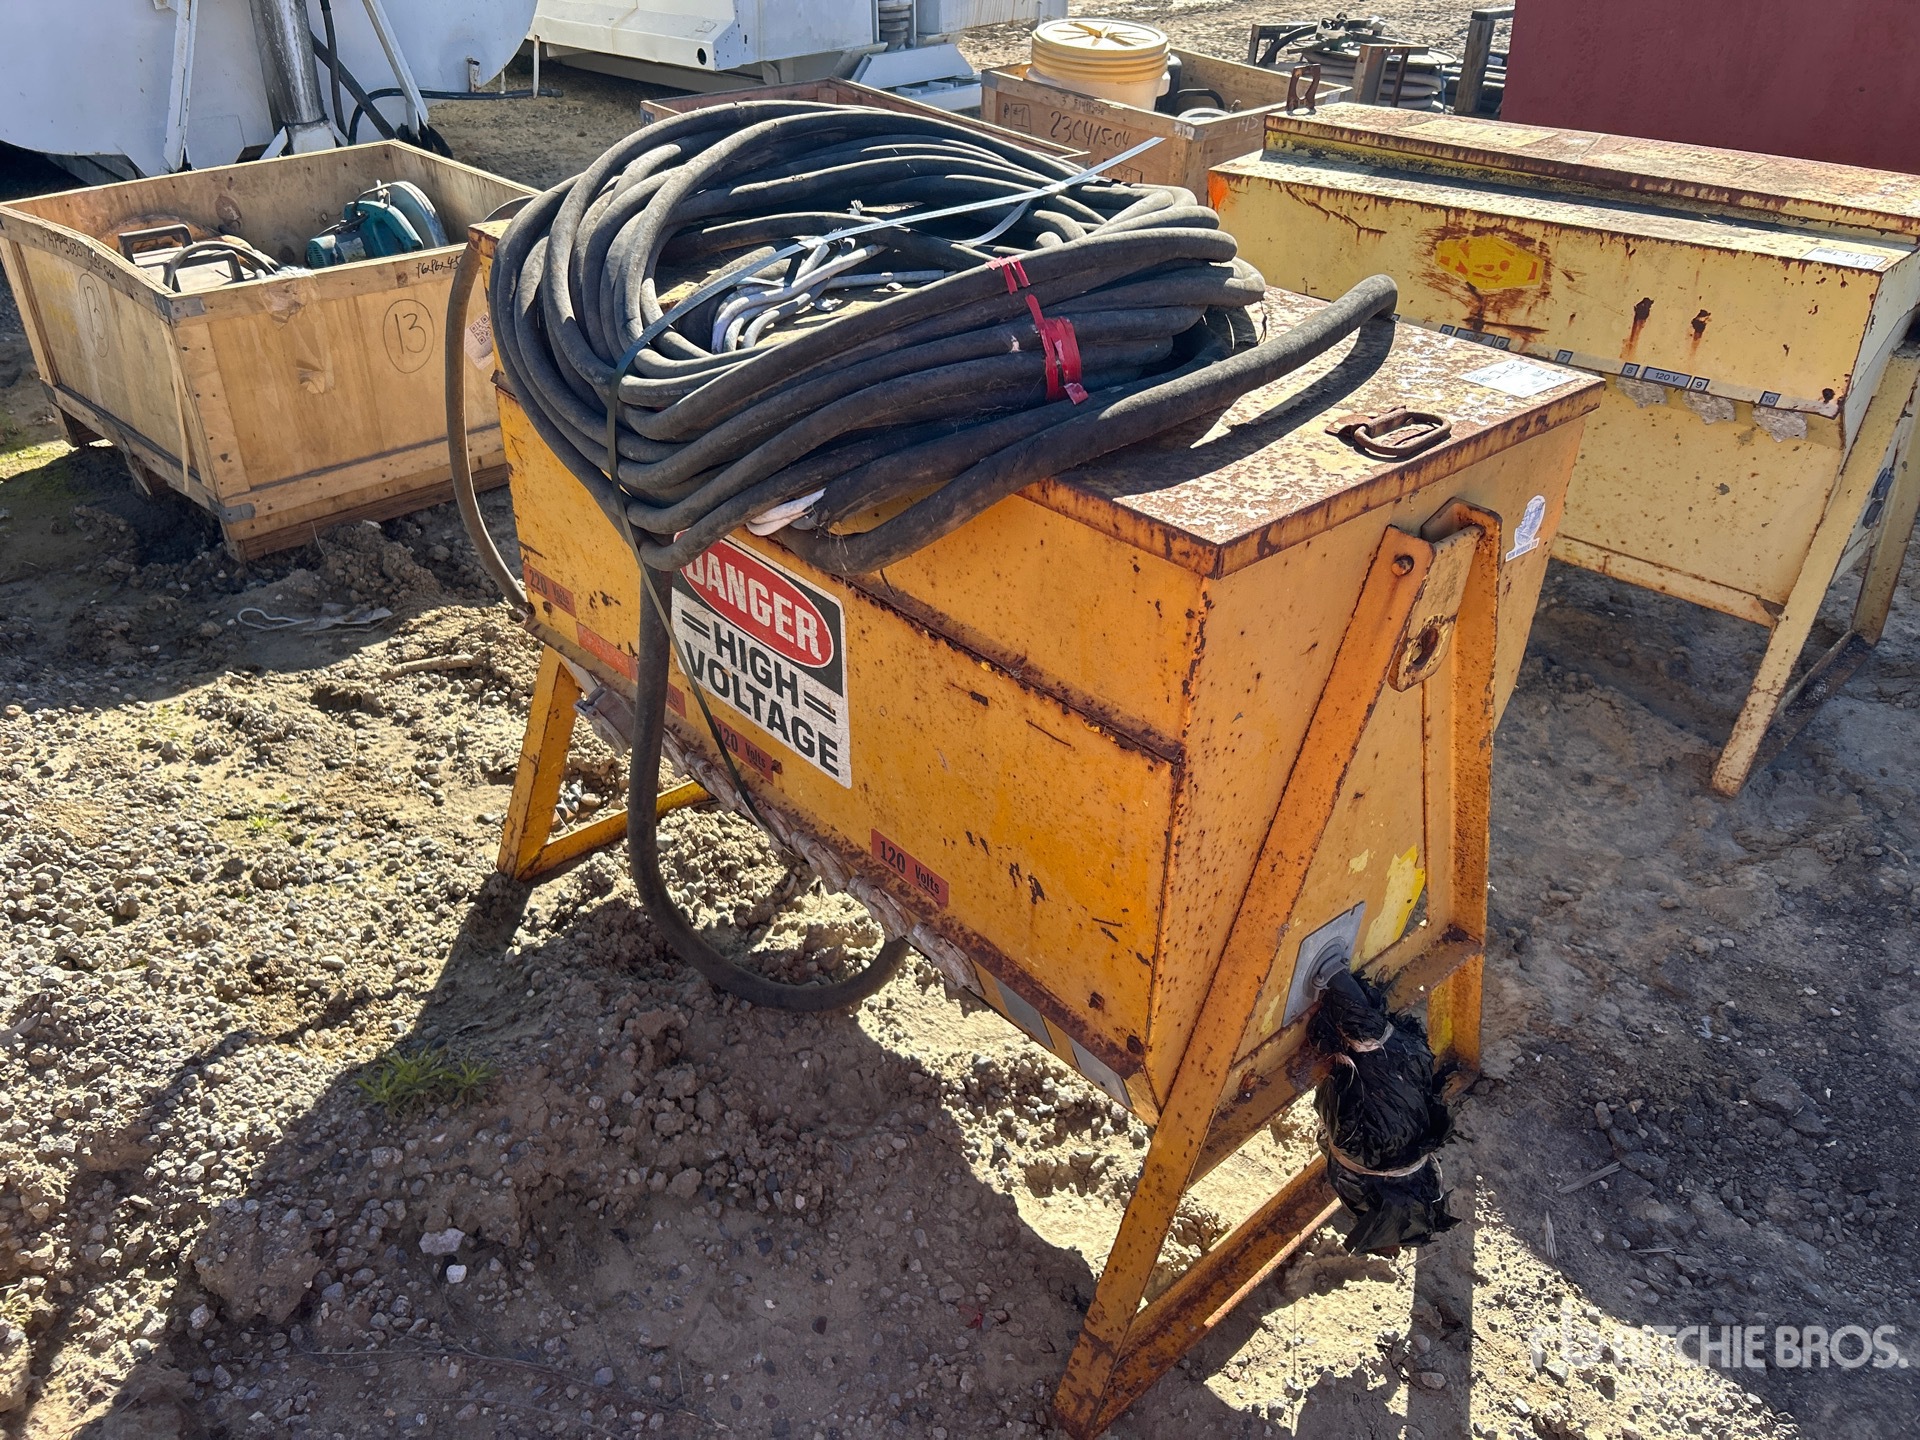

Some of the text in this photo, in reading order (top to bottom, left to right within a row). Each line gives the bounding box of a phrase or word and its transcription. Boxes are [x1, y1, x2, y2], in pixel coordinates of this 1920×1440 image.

[395, 312, 426, 355] 13
[1626, 366, 1634, 374] 8
[1655, 372, 1680, 383] 120 V
[1694, 381, 1703, 389] 9
[1764, 395, 1776, 404] 10
[528, 568, 570, 605] 220 Volts
[685, 552, 822, 662] DANGER
[713, 621, 800, 710] HIGH
[683, 640, 840, 777] VOLTAGE
[717, 723, 766, 769] 120 Volts
[880, 840, 940, 895] 120 Volts
